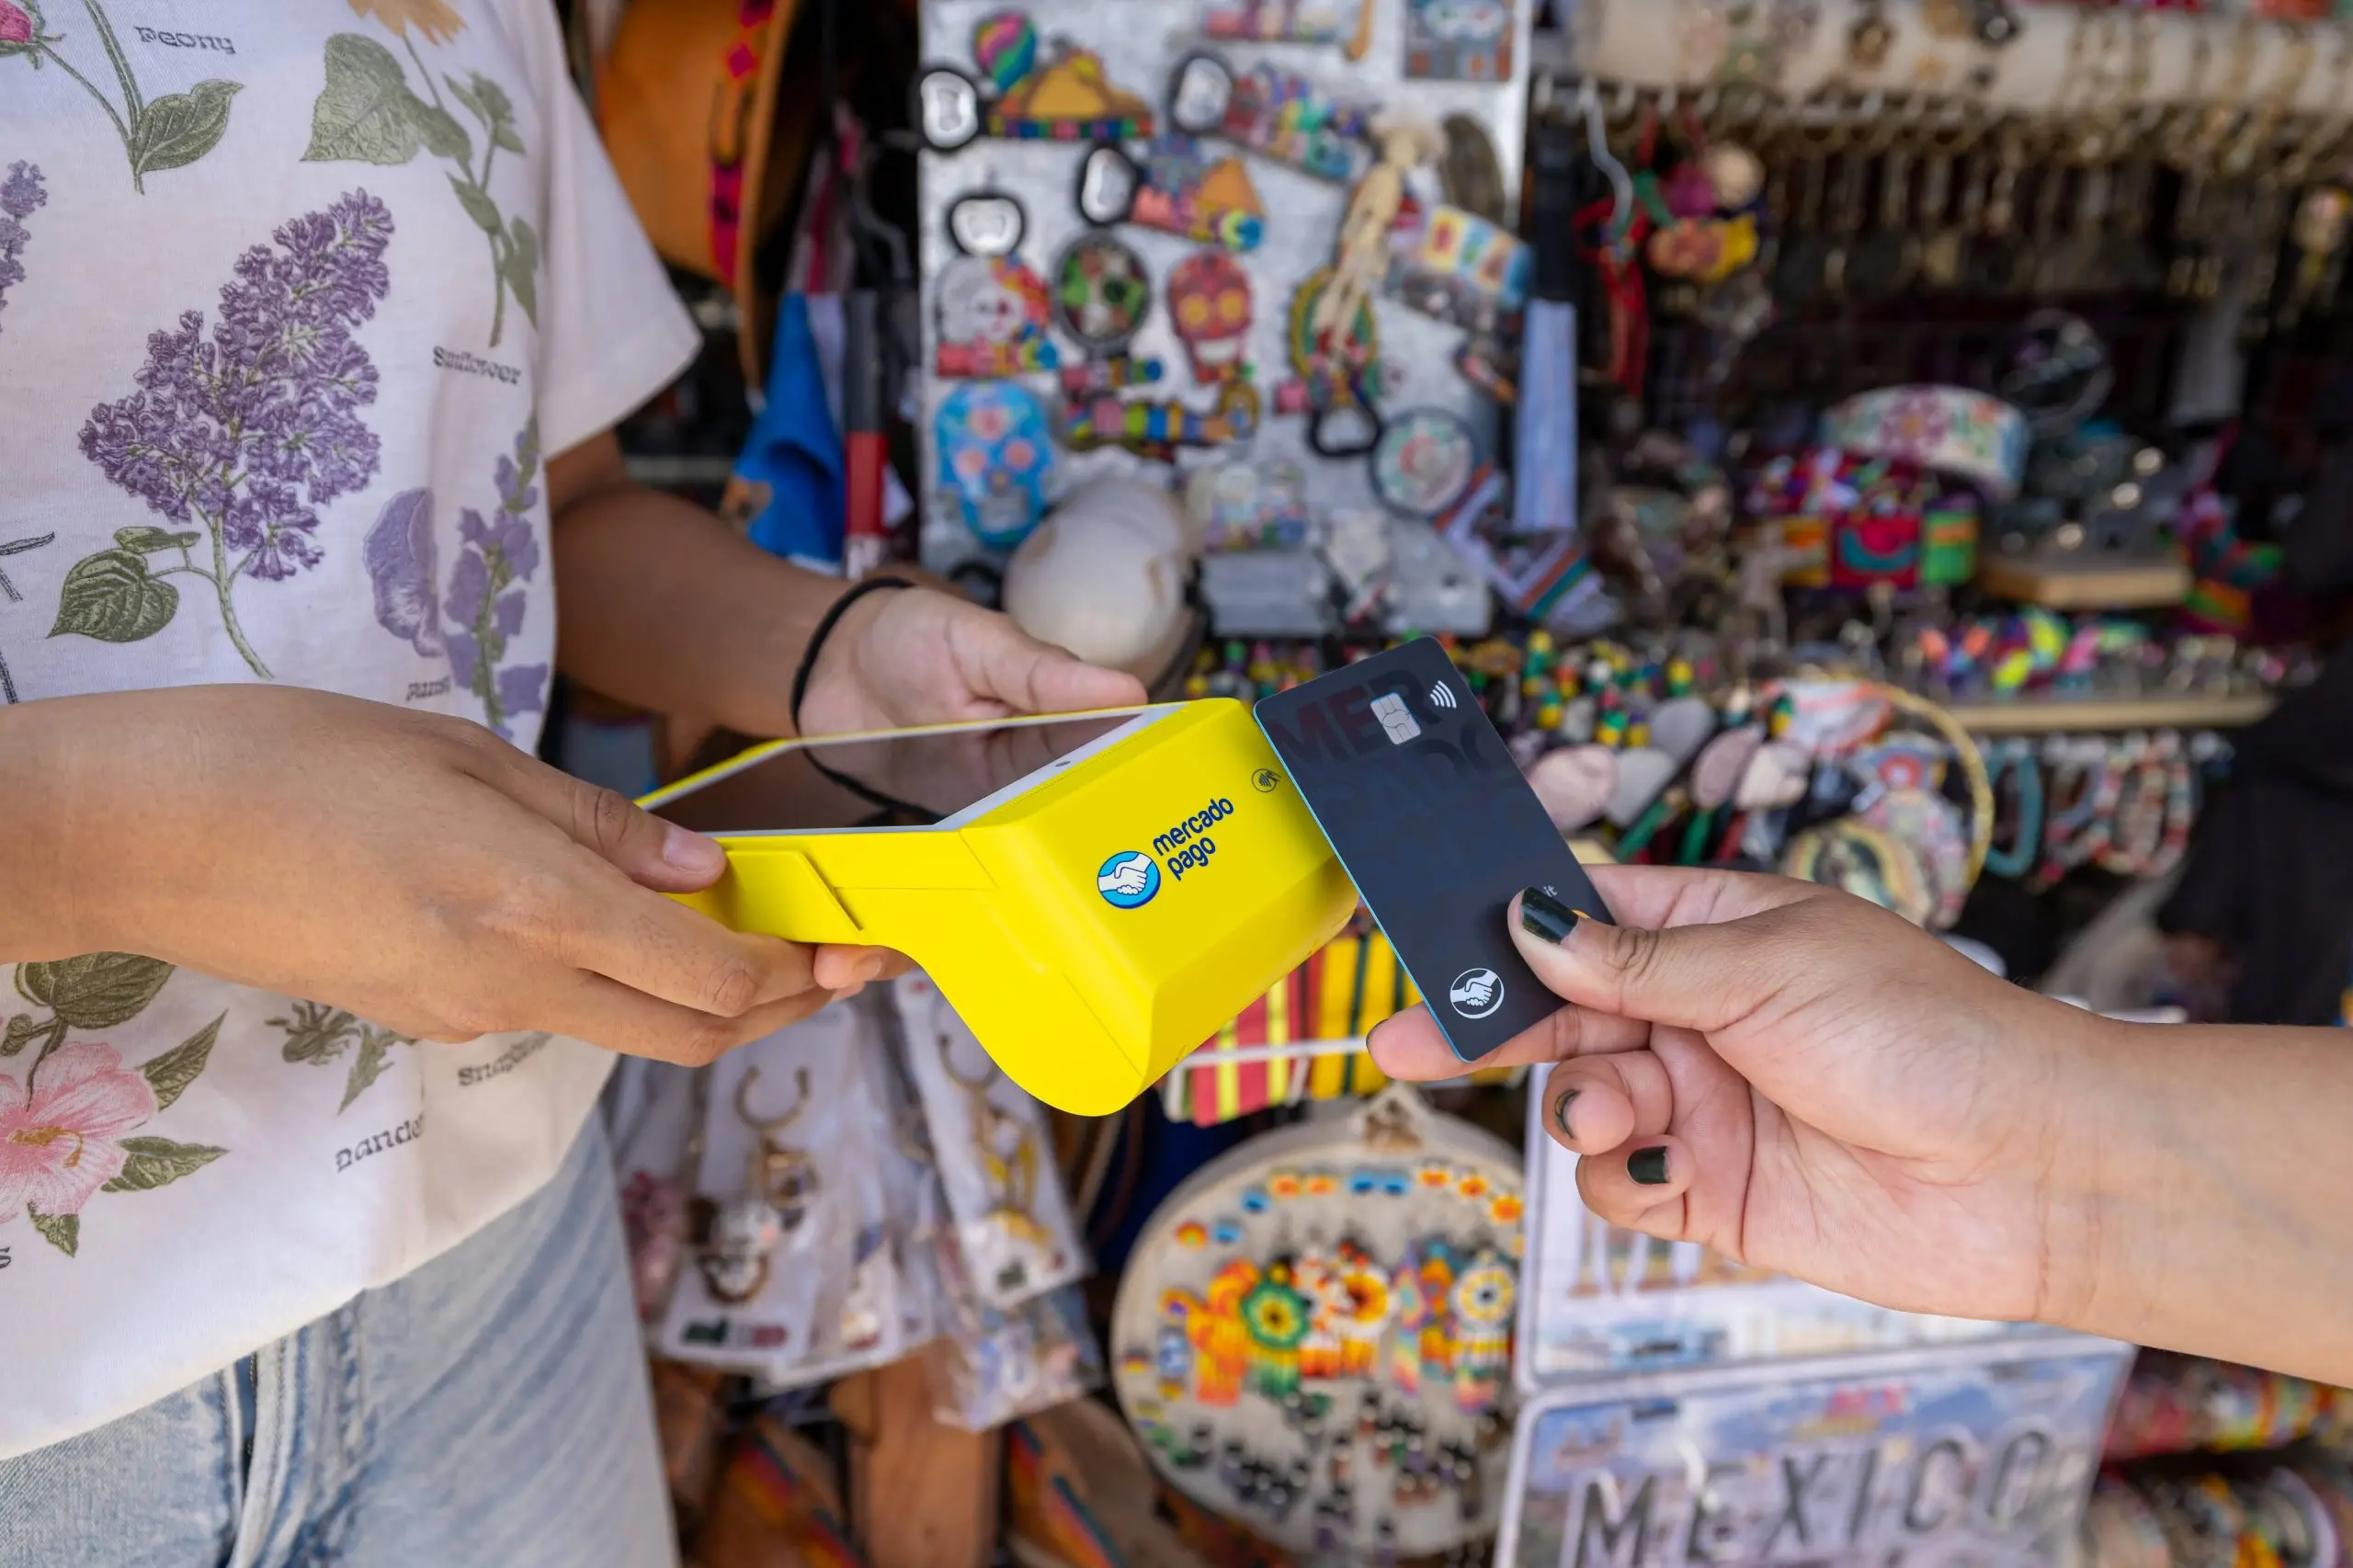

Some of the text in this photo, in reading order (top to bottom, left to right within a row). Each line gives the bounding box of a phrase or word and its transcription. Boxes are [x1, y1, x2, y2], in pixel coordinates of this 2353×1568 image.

[133, 26, 236, 54] Peony
[1153, 798, 1234, 856] mercado
[1166, 836, 1216, 881] pago
[1576, 1430, 2050, 1568] MEXICO
